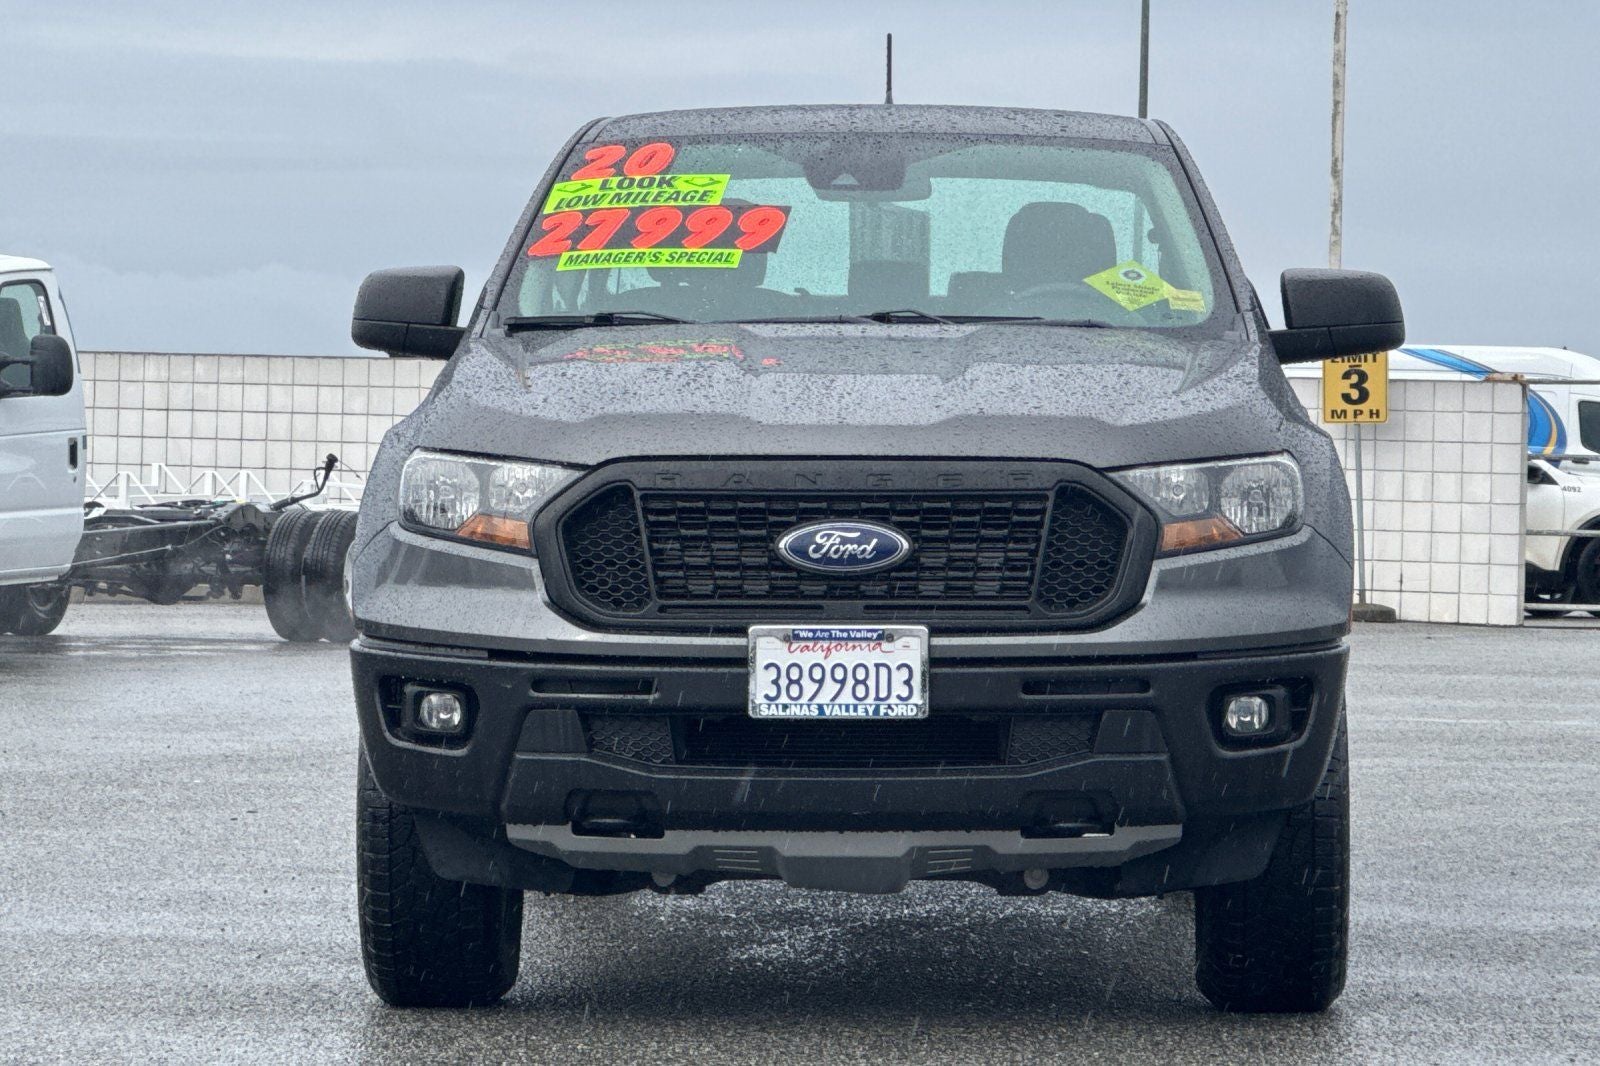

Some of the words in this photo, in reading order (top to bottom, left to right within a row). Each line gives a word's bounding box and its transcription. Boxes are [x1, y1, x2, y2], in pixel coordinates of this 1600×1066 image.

[571, 142, 675, 180] 20
[598, 176, 680, 191] LOOK
[553, 193, 607, 212] LOW
[607, 189, 717, 206] MILEAGE
[562, 251, 663, 267] MANAGER'S
[665, 251, 735, 265] SPECIAL
[1341, 368, 1370, 405] 3
[1330, 408, 1380, 419] MPH
[653, 472, 1035, 488] RANGER
[1561, 485, 1582, 493] 4092
[808, 530, 878, 559] Ford
[814, 630, 829, 638] Are
[831, 630, 849, 638] The
[787, 640, 894, 659] California
[763, 662, 914, 702] 38998D3
[823, 704, 876, 716] VALLEY
[879, 704, 917, 716] FORD
